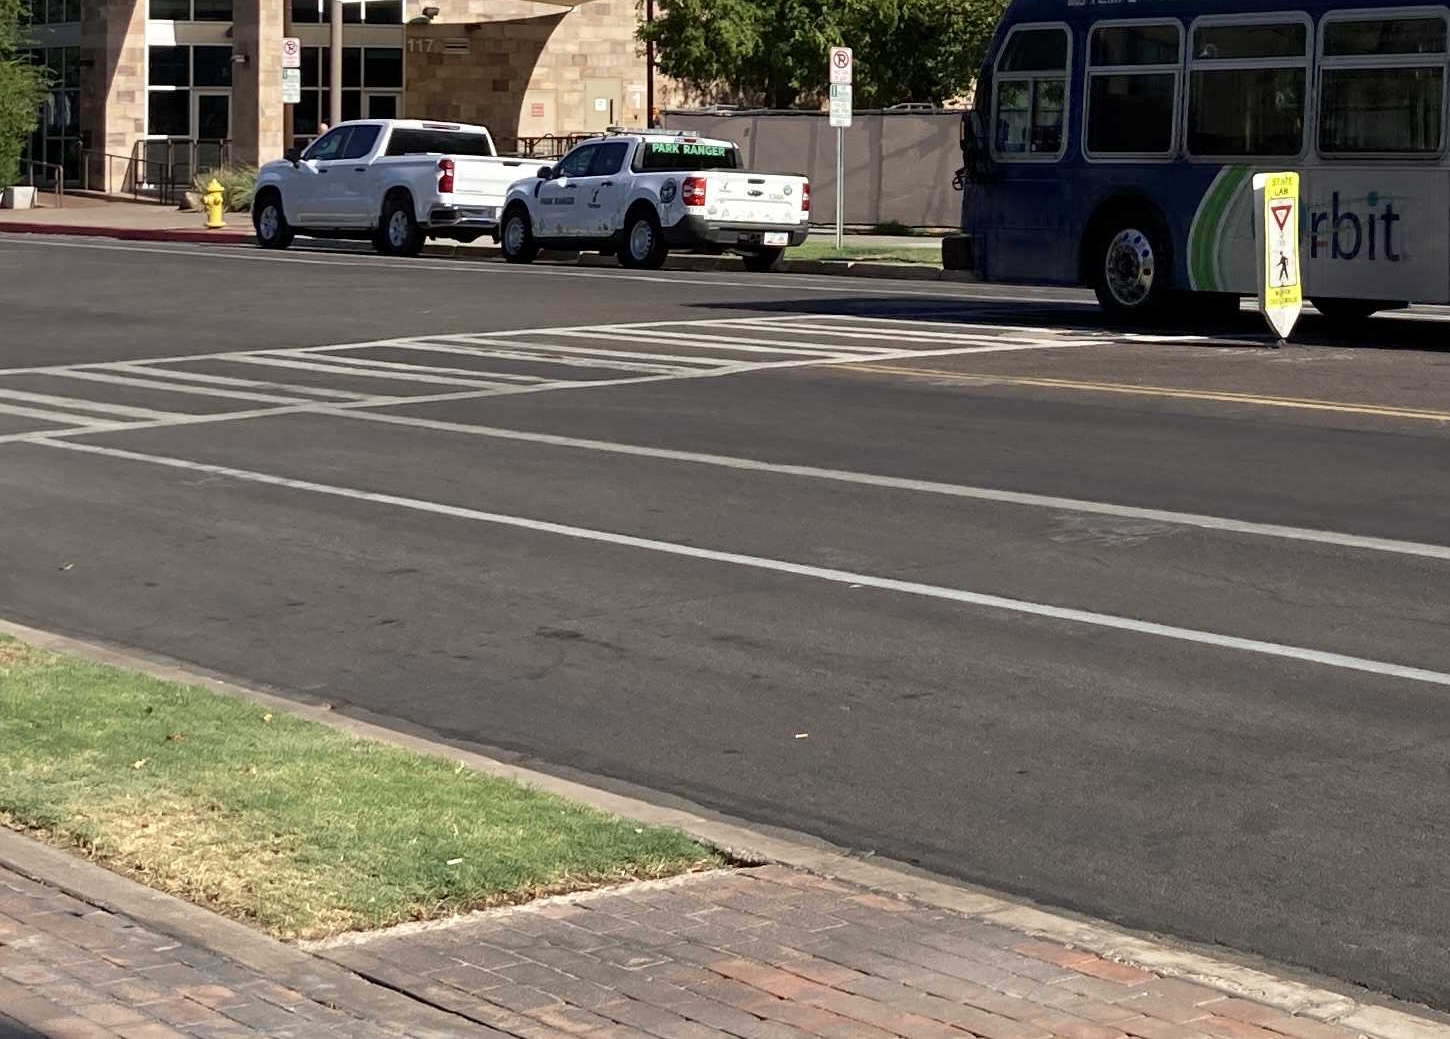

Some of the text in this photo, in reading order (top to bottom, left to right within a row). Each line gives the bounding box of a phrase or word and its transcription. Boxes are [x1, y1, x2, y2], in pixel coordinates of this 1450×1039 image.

[407, 38, 434, 53] 117
[652, 143, 726, 156] PARK RANGER
[1271, 176, 1293, 187] STATE
[1300, 191, 1400, 261] rbit
